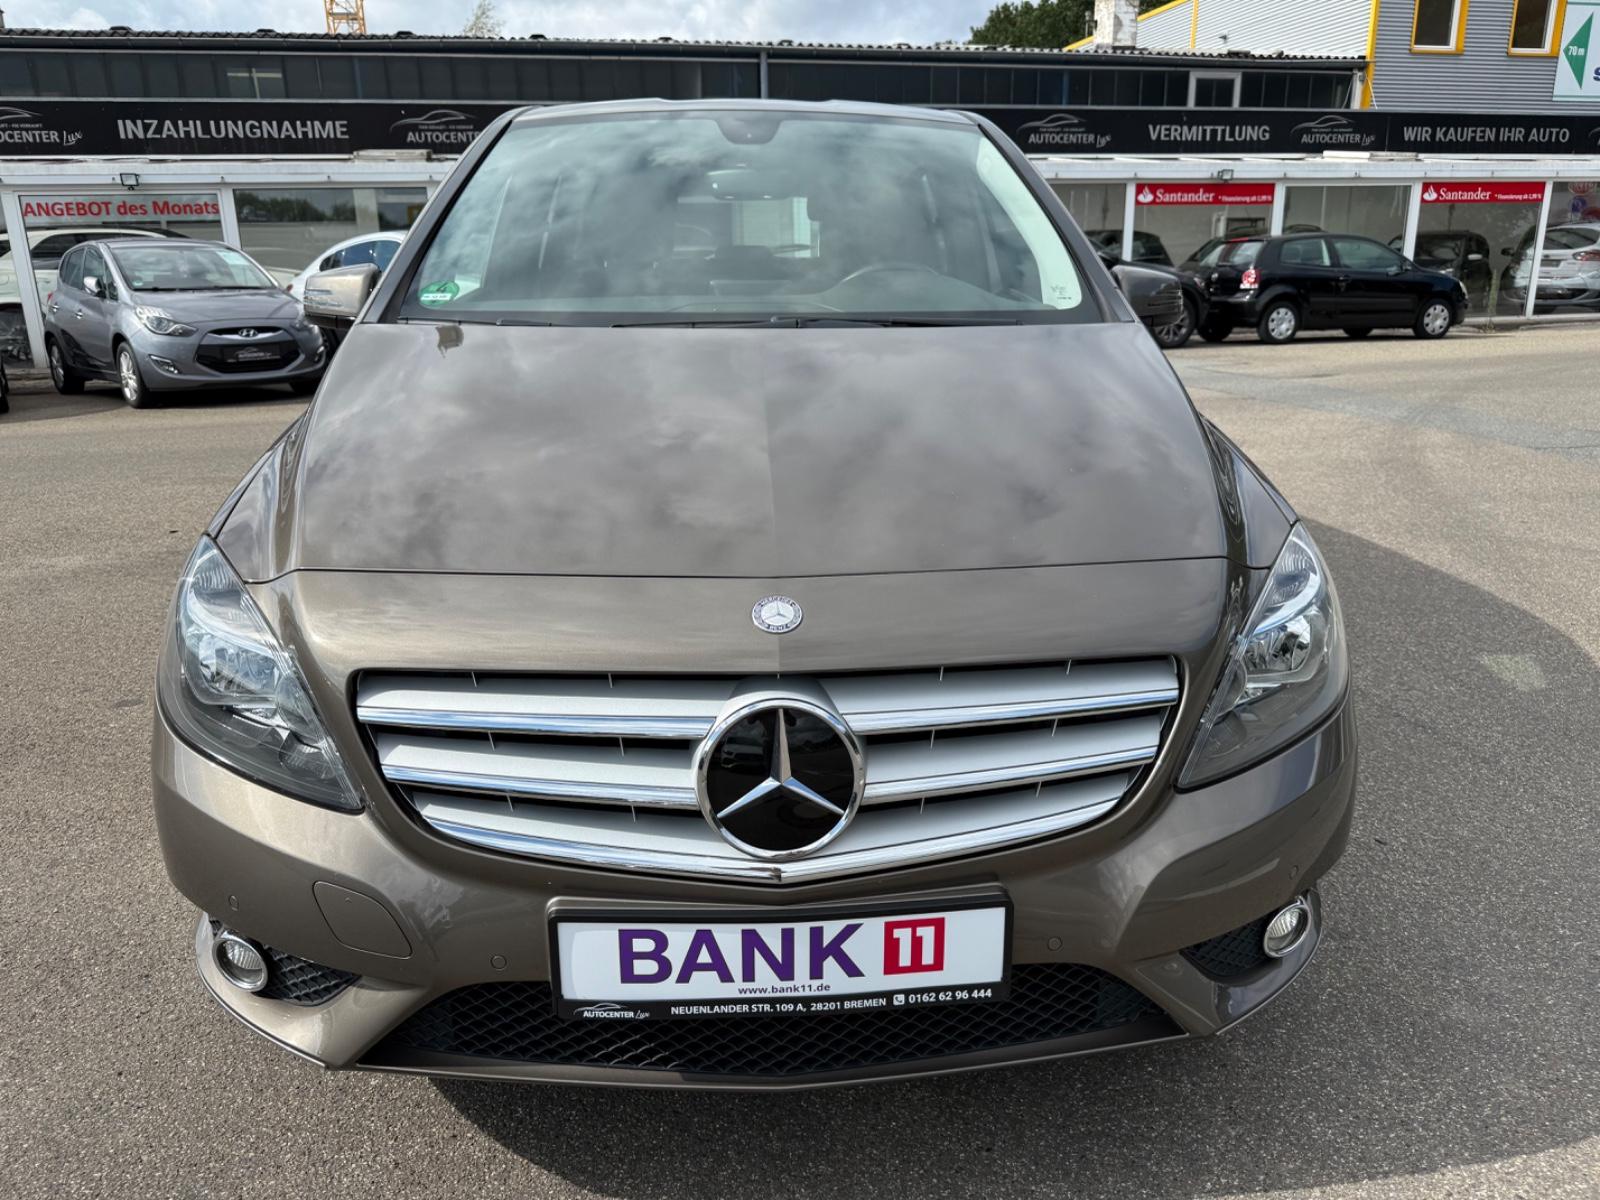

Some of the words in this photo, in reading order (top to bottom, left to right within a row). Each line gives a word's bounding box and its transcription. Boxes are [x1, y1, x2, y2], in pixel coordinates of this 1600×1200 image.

[1568, 45, 1577, 55] 70
[1578, 47, 1585, 55] m
[117, 119, 349, 139] INZAHLUNGNAHME
[1148, 124, 1271, 142] VERMITTLUNG
[1403, 126, 1431, 142] WIR
[1436, 126, 1495, 142] KAUFEN
[1499, 127, 1524, 143] IHR
[1528, 127, 1569, 143] AUTO
[1028, 133, 1095, 144] AUTOCENTER
[1301, 133, 1361, 144] AUTOCENTER
[1155, 188, 1215, 203] Santander
[1439, 187, 1491, 200] Santander
[22, 201, 111, 217] ANGEBOT
[116, 199, 148, 216] des
[152, 200, 219, 215] Monats
[618, 923, 866, 984] BANK
[893, 925, 936, 967] 11
[738, 983, 831, 995] www.bank11.de
[670, 1004, 749, 1015] NEUENLANDER
[751, 1004, 774, 1014] STR.
[775, 1003, 794, 1013] 109
[796, 1004, 807, 1013] A,
[810, 1001, 841, 1011] 28201
[844, 998, 887, 1009] BREMEN
[908, 992, 937, 1003] 0162
[938, 991, 954, 1001] 62
[955, 990, 969, 1000] 96
[971, 988, 992, 999] 444
[583, 1009, 634, 1019] AUTOCENTER
